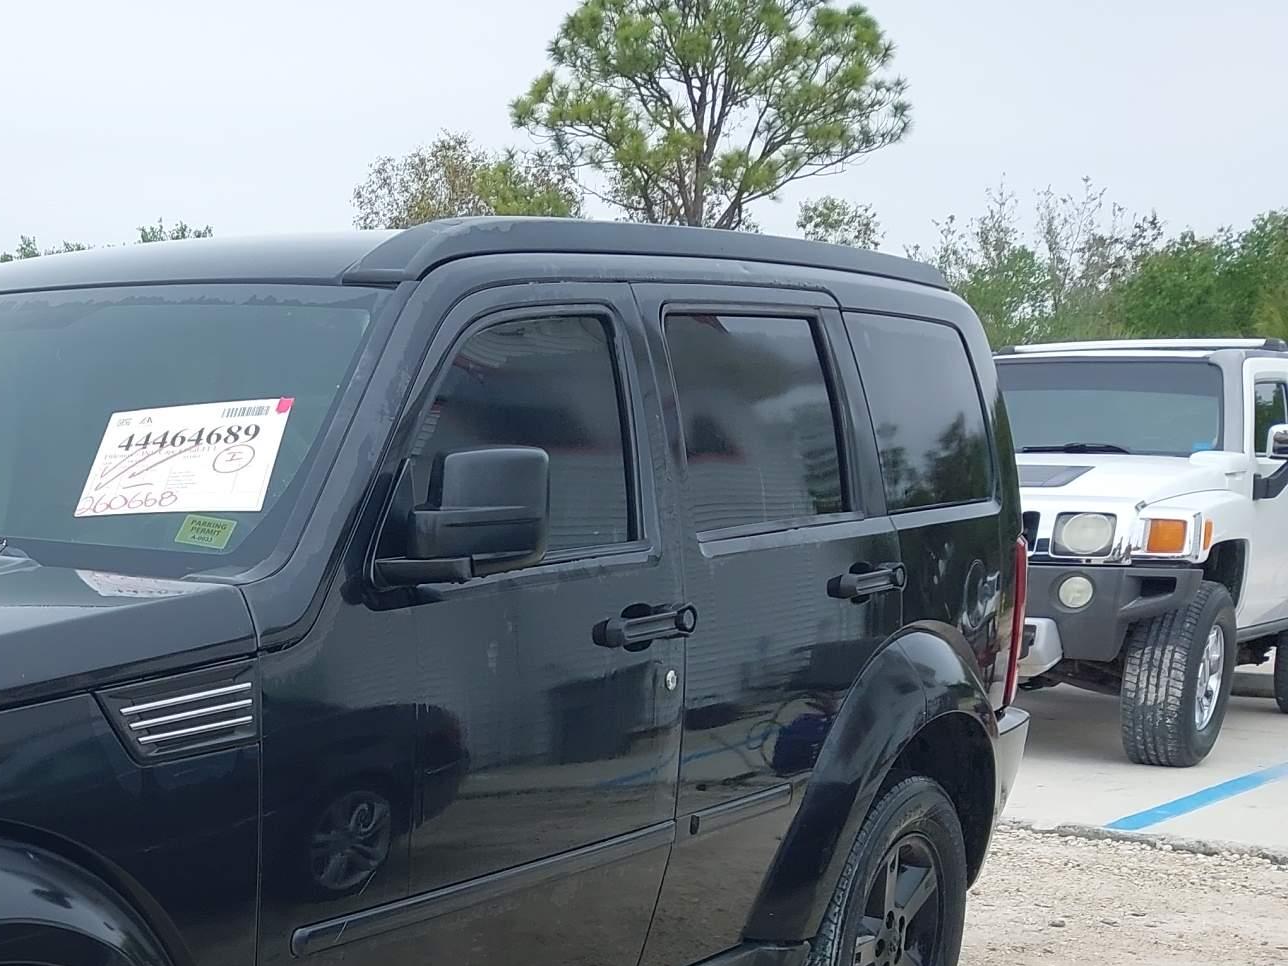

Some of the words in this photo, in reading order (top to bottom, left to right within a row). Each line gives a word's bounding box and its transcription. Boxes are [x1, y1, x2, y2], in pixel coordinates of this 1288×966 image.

[118, 423, 261, 451] 44464689
[191, 519, 227, 530] PARKING
[190, 526, 222, 537] PERMIT
